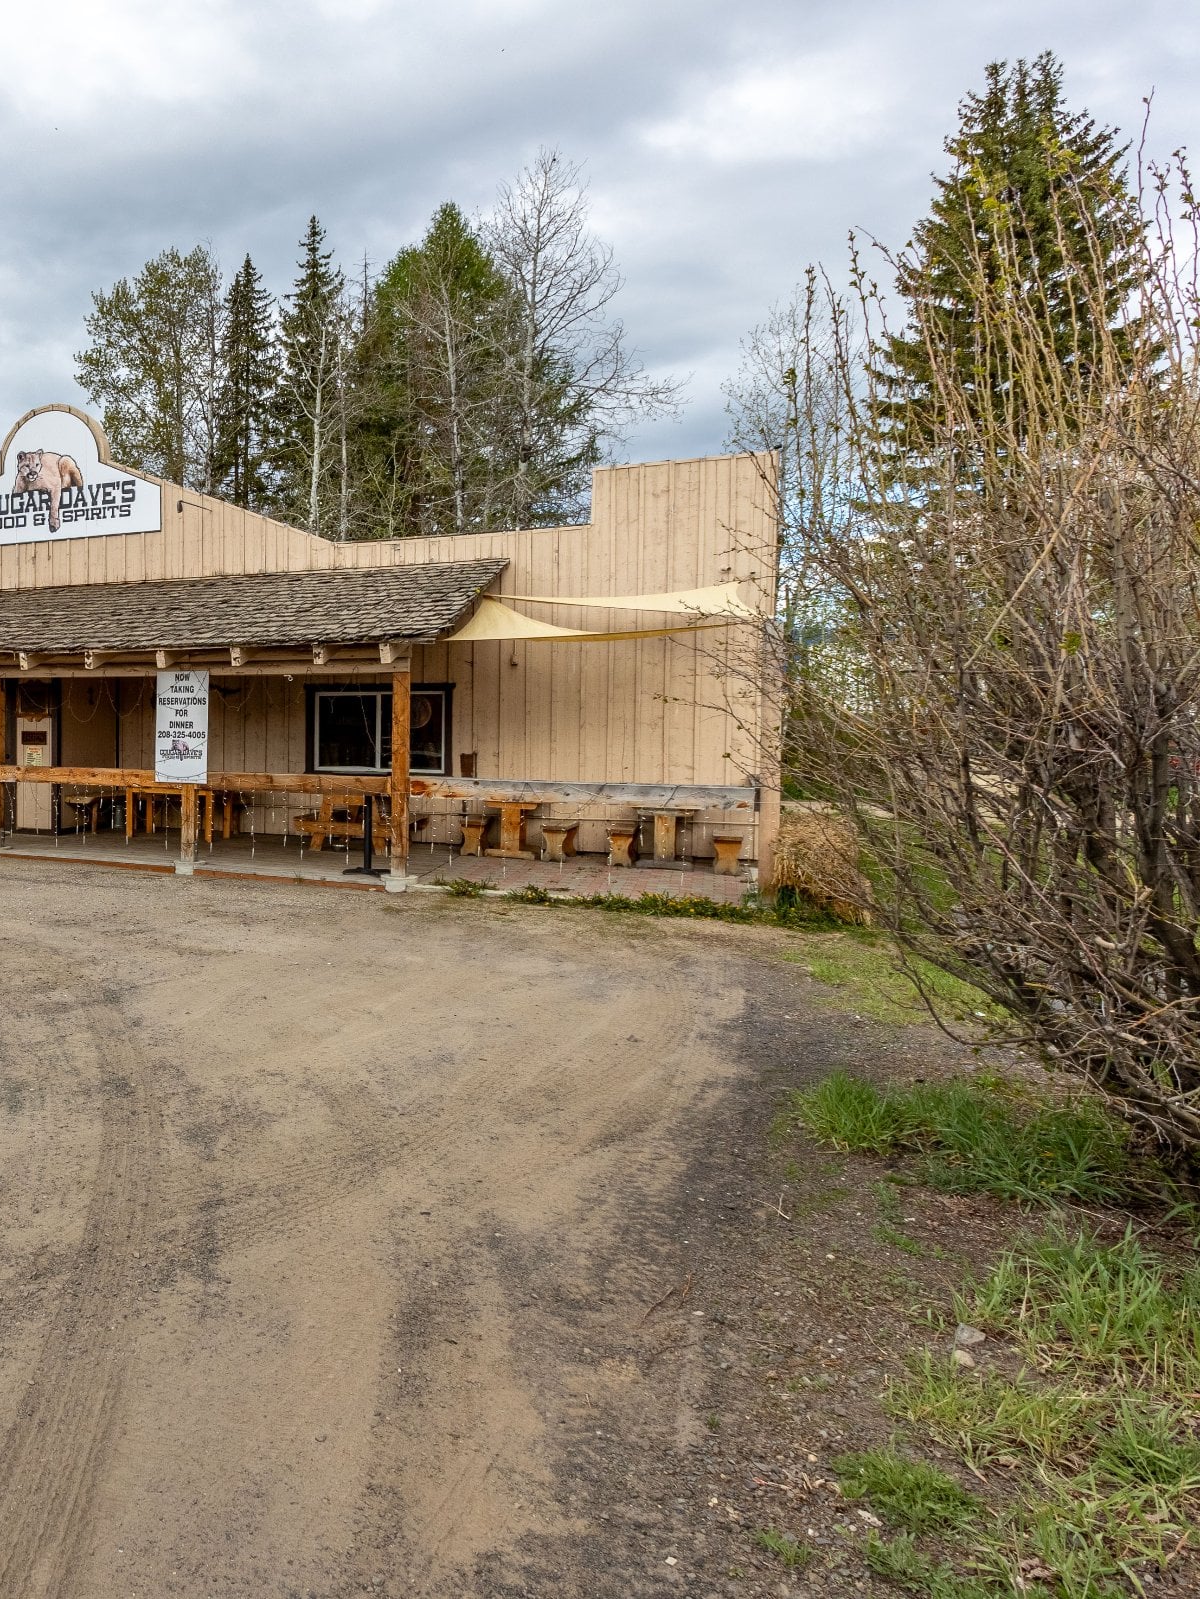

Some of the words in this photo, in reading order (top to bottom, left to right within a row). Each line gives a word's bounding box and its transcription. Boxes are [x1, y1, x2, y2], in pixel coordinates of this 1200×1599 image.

[59, 479, 136, 510] DAVE'S
[33, 513, 46, 527] &
[62, 504, 131, 523] SPIRITS
[175, 673, 190, 681] NOW
[170, 685, 194, 693] TAKING
[158, 697, 207, 706] RESERVATIONS
[175, 709, 188, 717] FOR
[169, 721, 194, 729] DINNER
[157, 731, 206, 739] 208-325-4005
